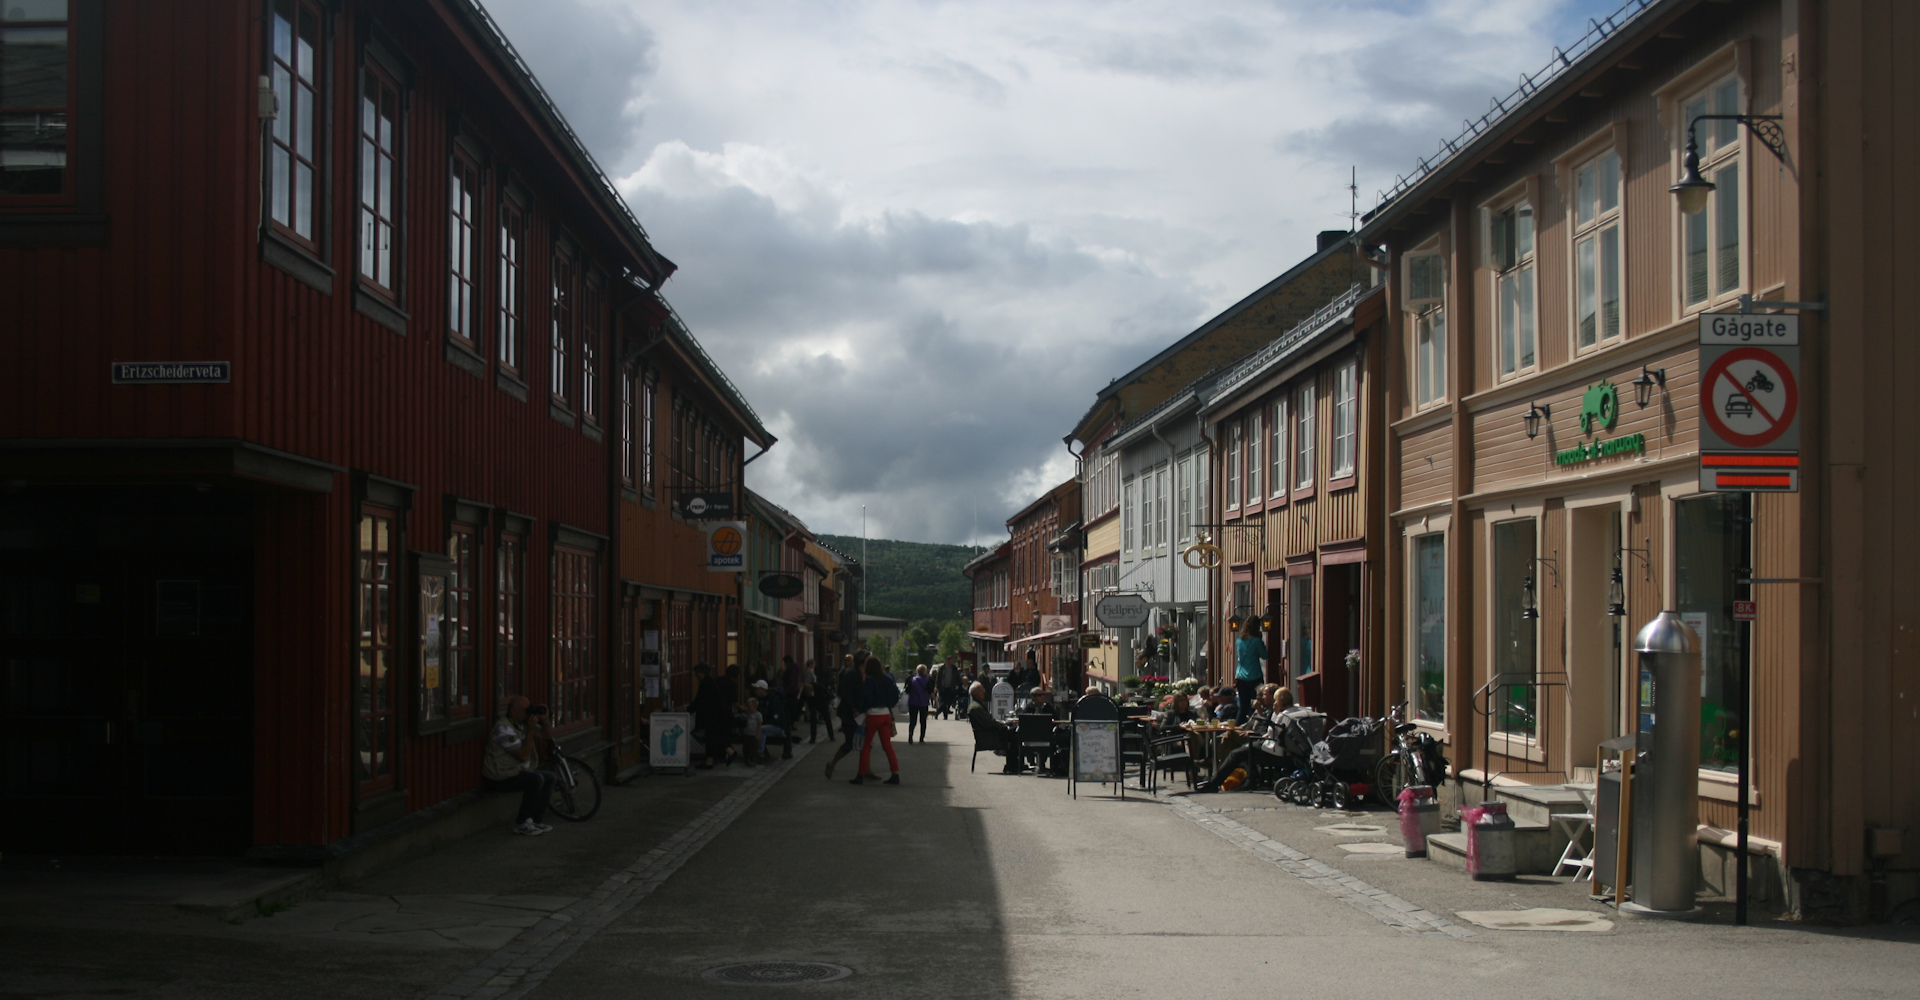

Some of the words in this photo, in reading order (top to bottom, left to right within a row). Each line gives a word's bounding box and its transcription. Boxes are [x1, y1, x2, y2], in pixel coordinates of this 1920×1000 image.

[1712, 317, 1786, 341] Gågate
[121, 365, 222, 379] Ertzscheiderveta
[1556, 441, 1587, 466] moods
[1600, 432, 1644, 457] norway
[713, 556, 740, 565] apotek
[1102, 604, 1143, 616] Fjellpryd
